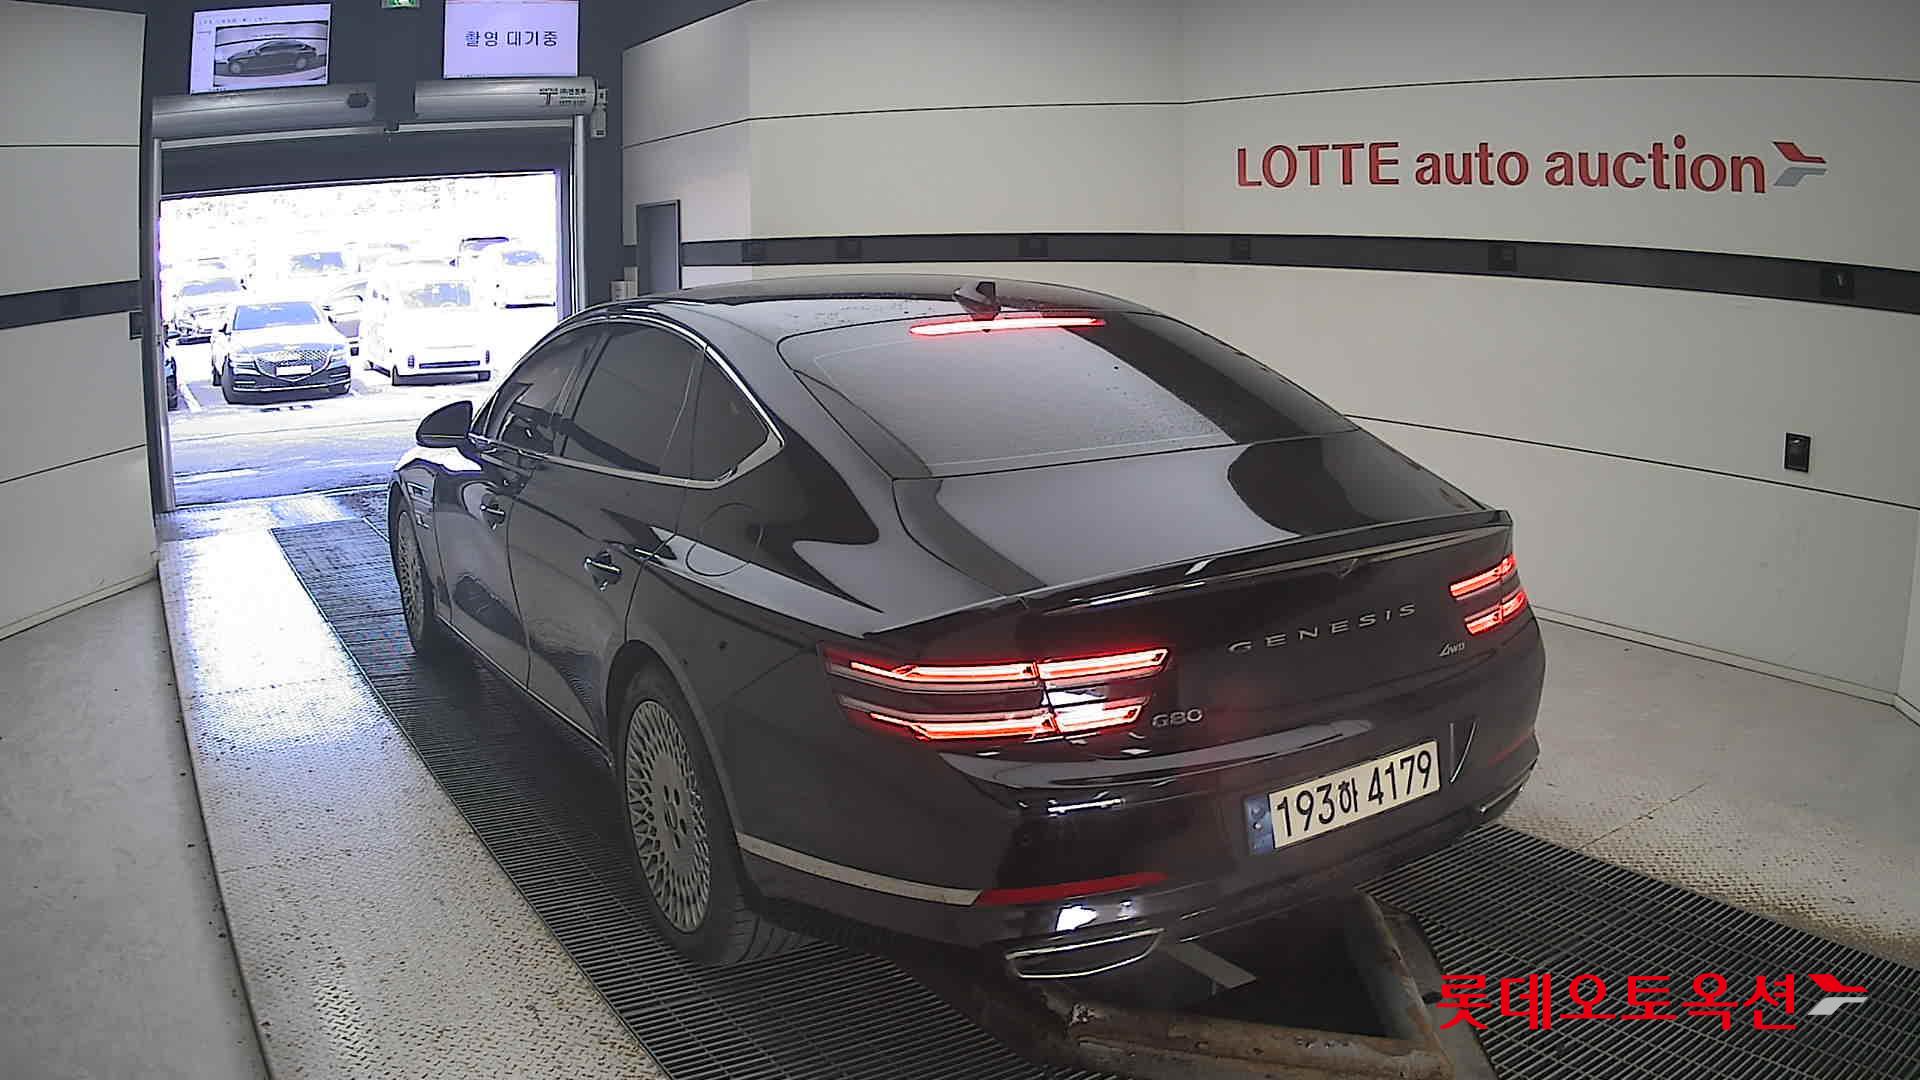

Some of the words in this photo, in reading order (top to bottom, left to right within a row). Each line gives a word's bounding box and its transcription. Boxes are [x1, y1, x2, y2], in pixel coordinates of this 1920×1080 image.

[507, 31, 558, 48] 대기중
[1237, 141, 1400, 189] LOTTE
[1415, 142, 1529, 187] auto
[1544, 134, 1767, 194] auction
[1228, 603, 1417, 653] GENESIS
[1152, 707, 1204, 729] G80
[1276, 777, 1359, 837] 193하
[1367, 749, 1434, 806] 4179
